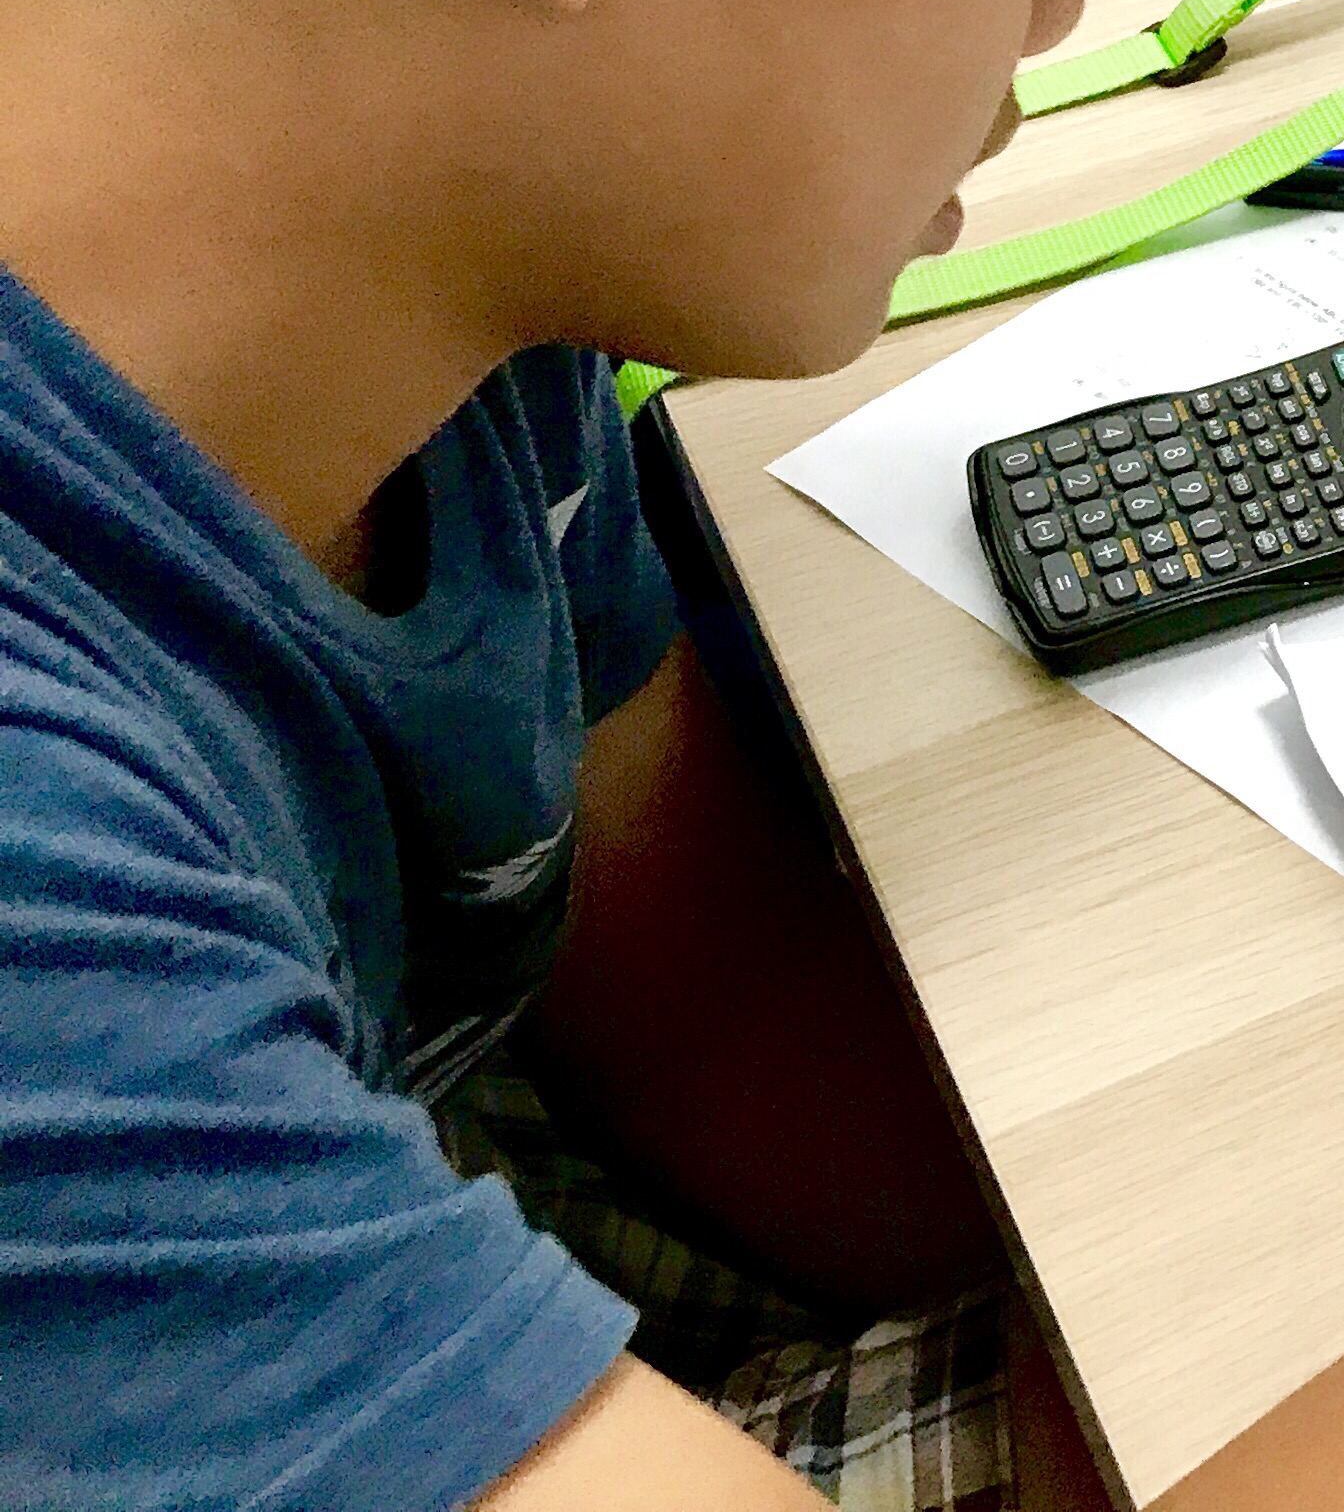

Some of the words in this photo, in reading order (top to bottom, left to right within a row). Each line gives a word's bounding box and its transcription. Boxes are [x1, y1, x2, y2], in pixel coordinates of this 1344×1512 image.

[1148, 412, 1173, 422] 7
[1102, 428, 1124, 439] 4
[1294, 422, 1311, 442] cos
[1060, 441, 1078, 450] 1
[1009, 452, 1029, 466] 0
[1163, 446, 1187, 460] 8
[1307, 450, 1324, 469] tan
[1116, 461, 1141, 474] 5
[1067, 474, 1091, 489] 2
[1178, 482, 1203, 493] 9
[1231, 471, 1249, 493] STO
[1131, 498, 1155, 510] 6
[1081, 510, 1106, 524] 3
